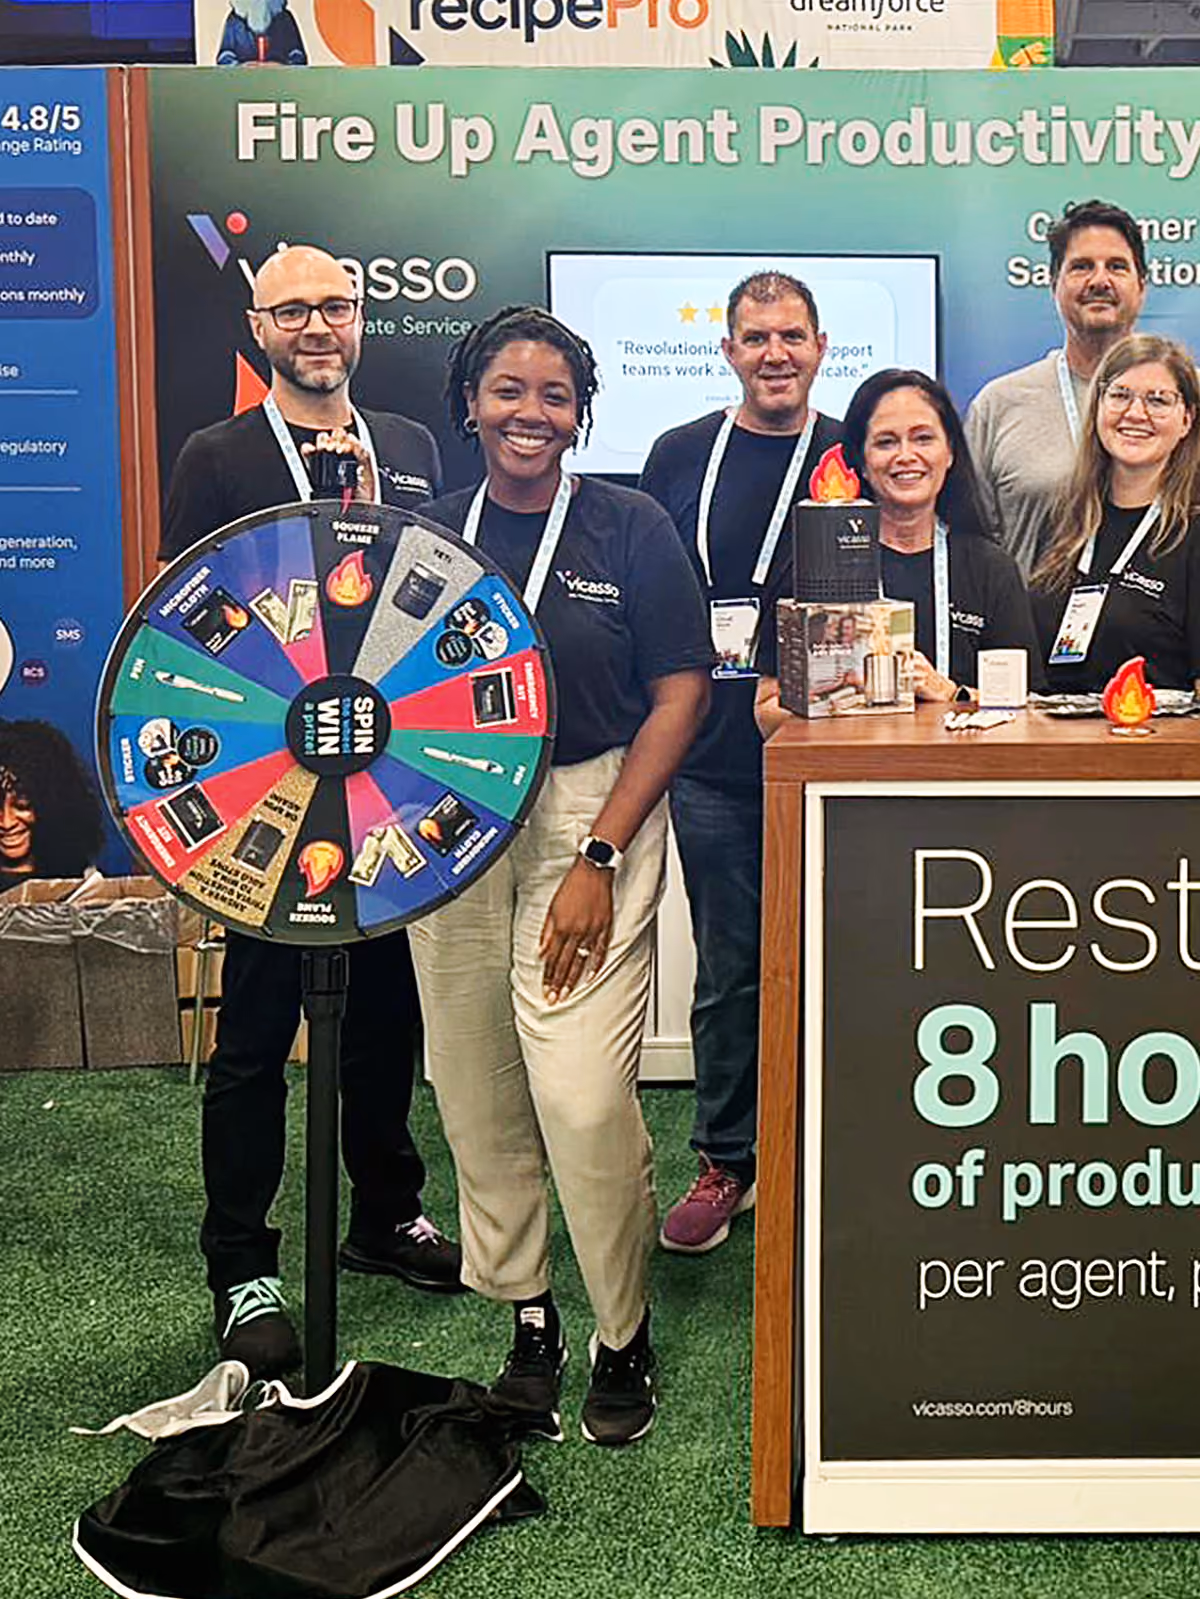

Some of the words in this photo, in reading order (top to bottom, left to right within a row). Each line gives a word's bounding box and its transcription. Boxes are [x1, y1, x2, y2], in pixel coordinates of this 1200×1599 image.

[1, 104, 81, 134] 4.8/5
[0, 139, 30, 156] nge
[33, 138, 82, 155] Rating
[237, 102, 376, 162] Fire
[396, 103, 495, 177] Up
[514, 103, 740, 178] Agent
[25, 212, 58, 225] date
[1027, 210, 1198, 242] Cmer
[237, 241, 477, 302] asso
[28, 288, 86, 304] monthly
[402, 315, 473, 336] Service
[830, 344, 873, 361] pport
[622, 364, 671, 377] teams
[675, 361, 713, 377] work
[20, 557, 56, 569] more
[178, 583, 210, 614] CLOTH
[566, 576, 620, 598] vicasso
[55, 629, 82, 641] SMS
[317, 697, 340, 756] WIN
[353, 696, 375, 754] SPIN
[912, 1003, 1000, 1128] 8
[912, 1148, 986, 1209] of
[919, 1257, 1004, 1309] per
[1018, 1250, 1175, 1310] agent,
[912, 1397, 1074, 1417] vicasso.com/8hours
